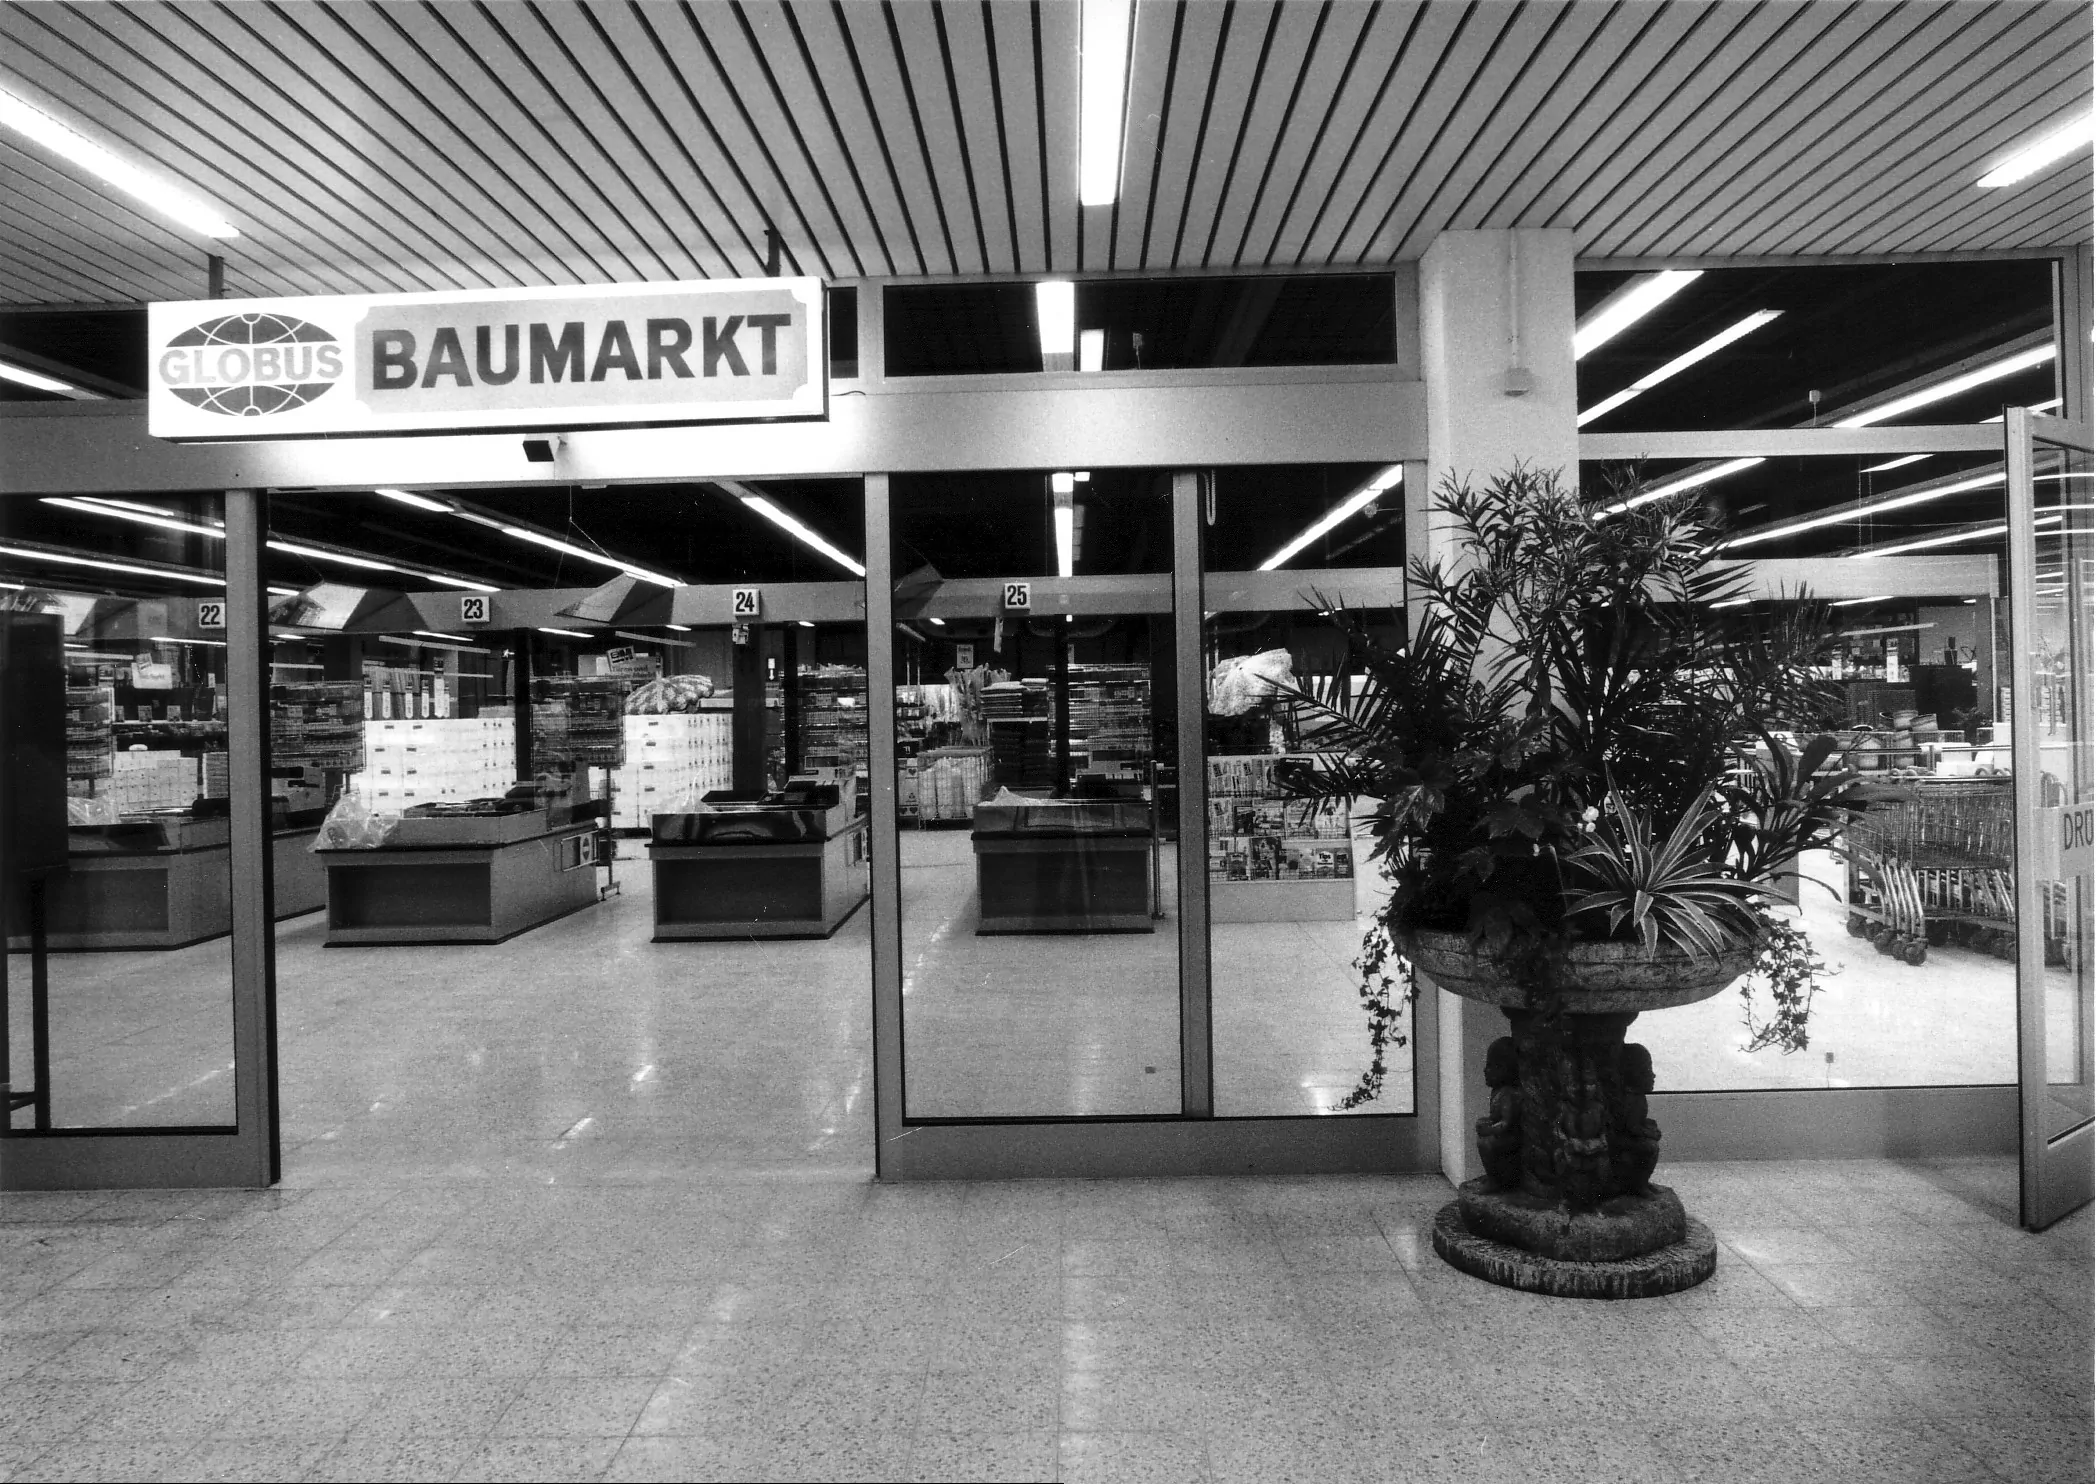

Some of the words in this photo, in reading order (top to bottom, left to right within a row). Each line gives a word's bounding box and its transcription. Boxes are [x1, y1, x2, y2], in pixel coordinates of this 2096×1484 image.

[372, 313, 791, 390] BAUMARKT
[158, 344, 344, 386] GLOBUS
[735, 592, 754, 612] 24
[1007, 585, 1027, 606] 25
[201, 604, 220, 626] 22
[464, 598, 483, 619] 23
